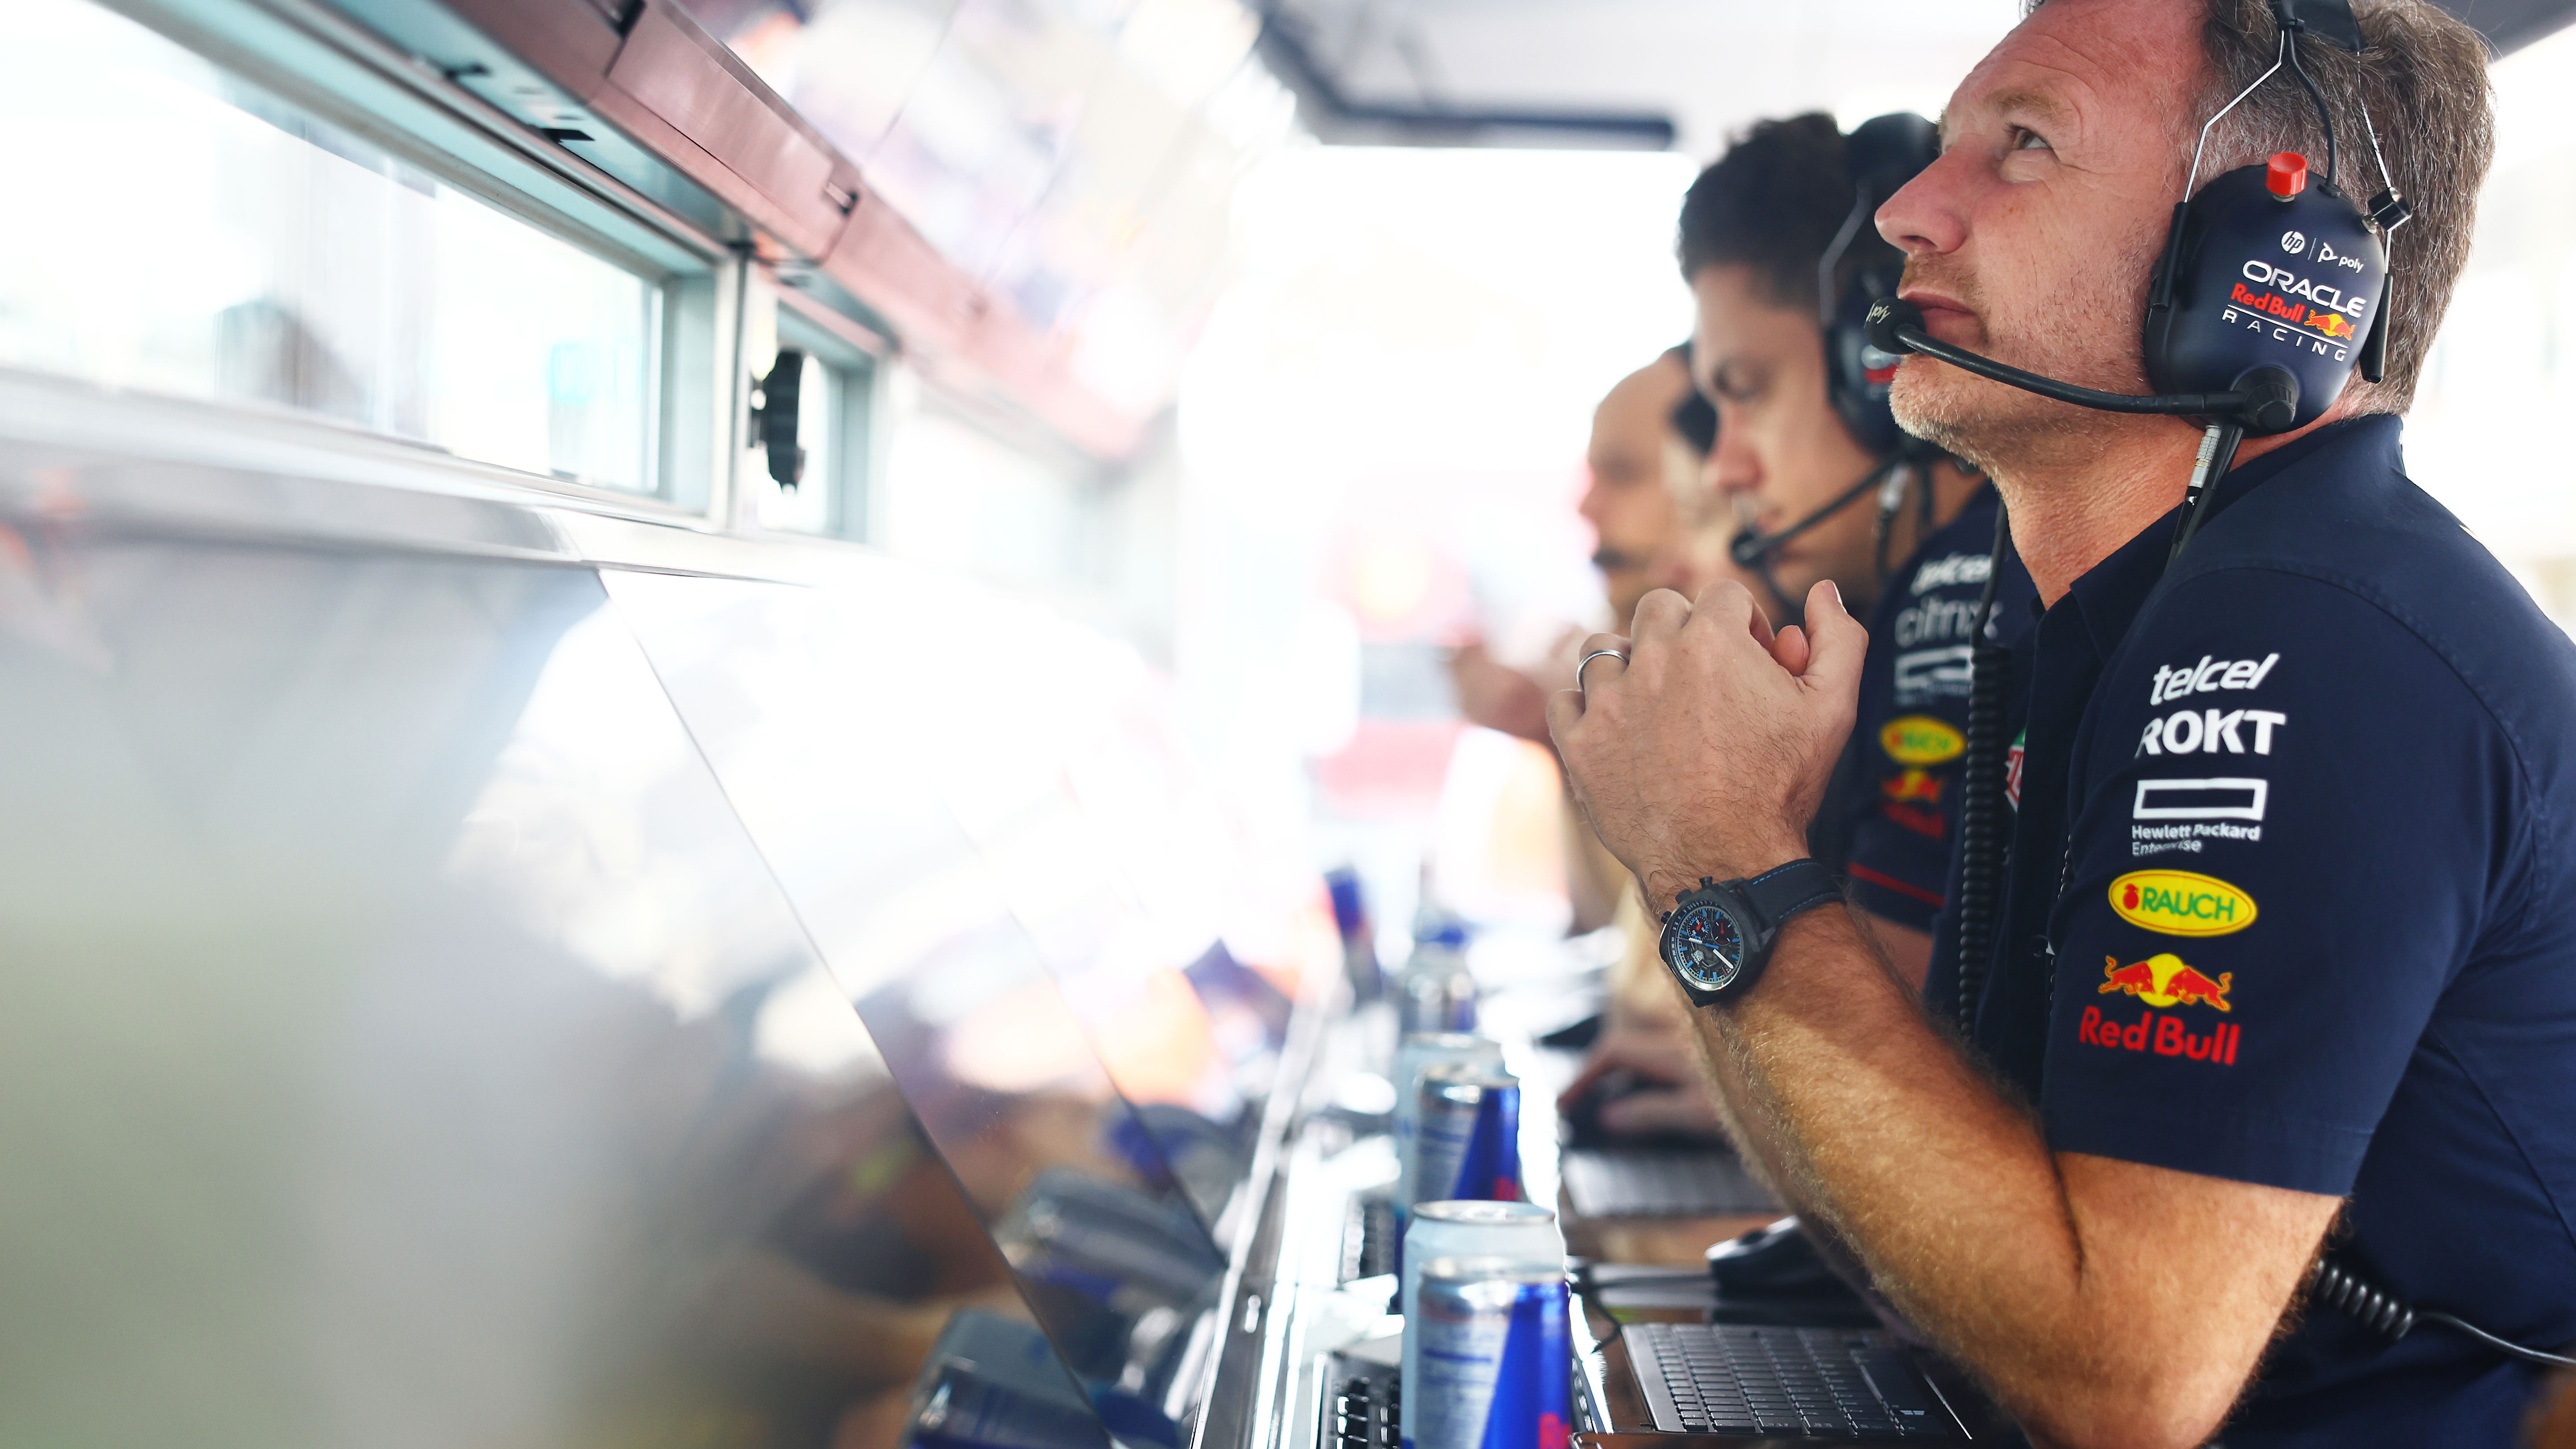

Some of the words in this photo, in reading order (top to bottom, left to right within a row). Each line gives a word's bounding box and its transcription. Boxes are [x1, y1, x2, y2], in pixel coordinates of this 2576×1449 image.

[2282, 231, 2305, 254] hp
[2339, 256, 2363, 273] poly
[2242, 260, 2366, 318] ORACLE
[2222, 309, 2347, 362] RACING
[2150, 653, 2280, 706] telcel
[2134, 709, 2286, 759] ROKT
[2132, 825, 2191, 840] Hewlett
[2192, 822, 2261, 841] Packard
[2141, 887, 2235, 922] RAUCH
[2079, 1005, 2153, 1052] Red
[2153, 1015, 2241, 1066] Bull
